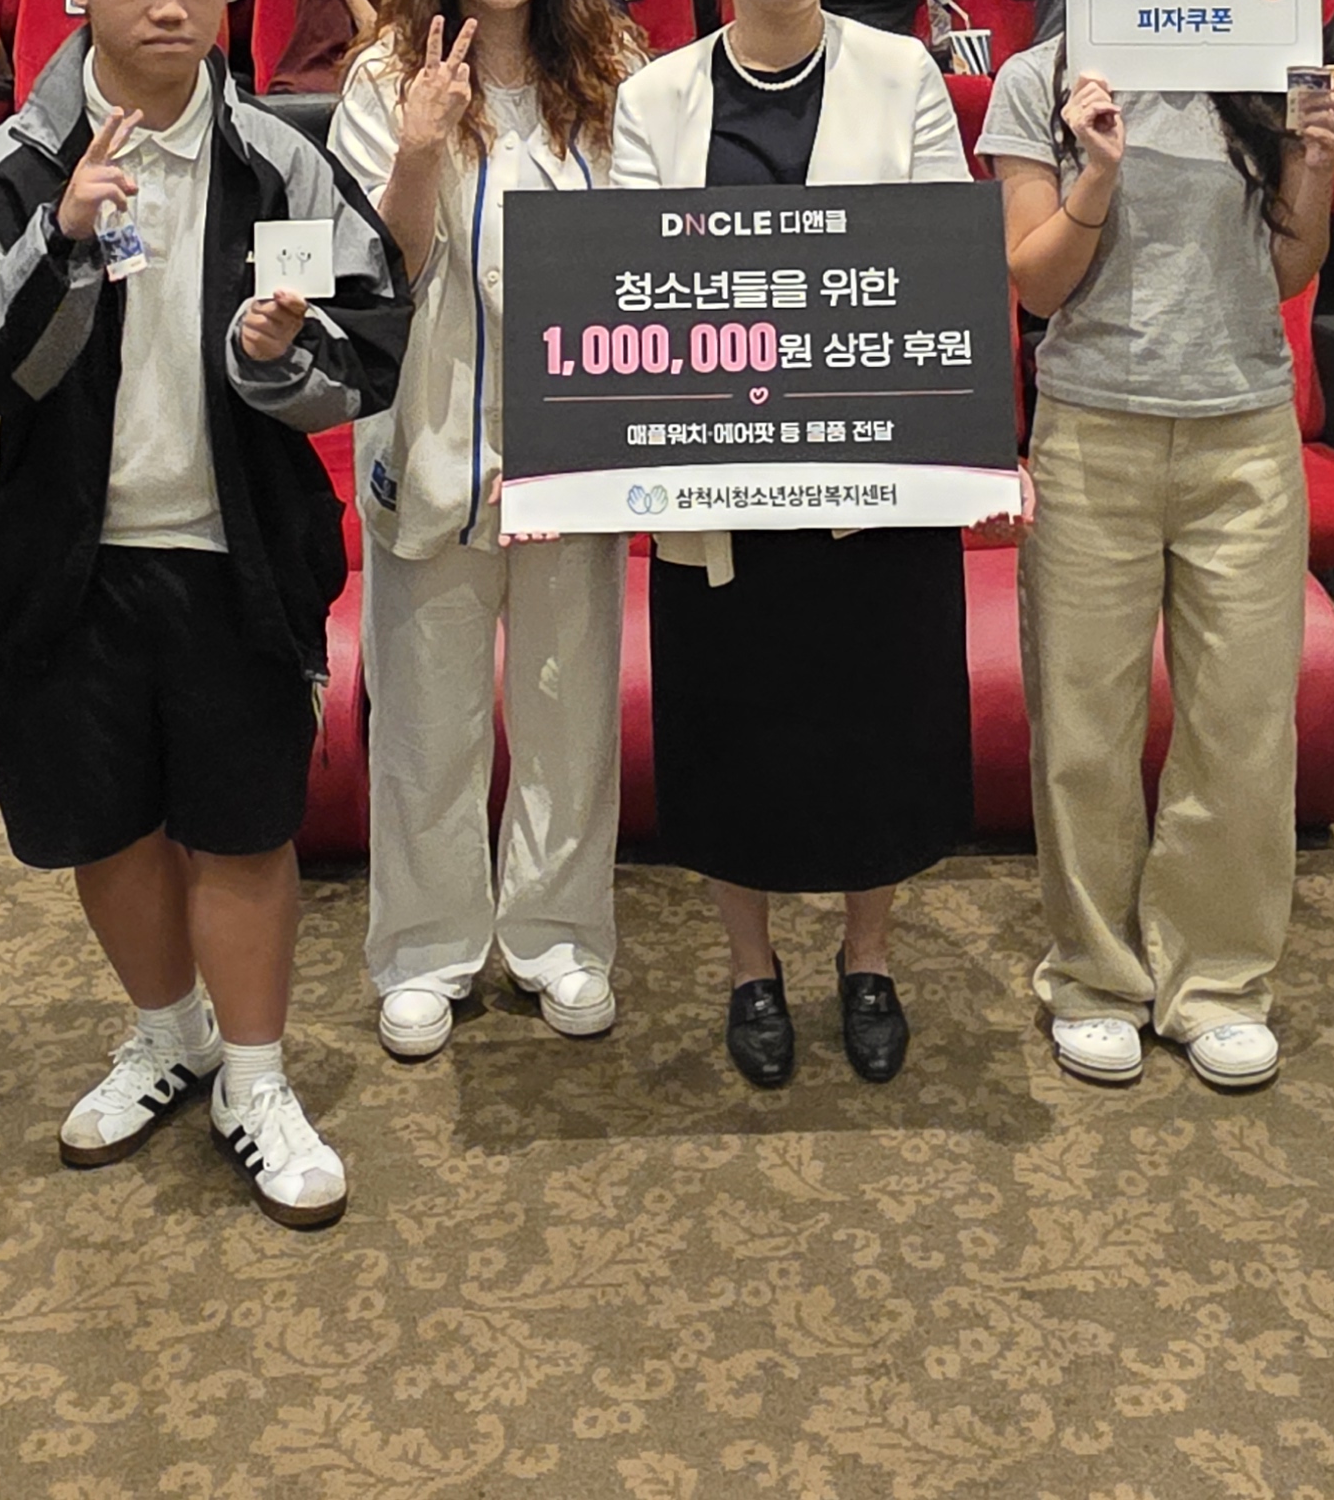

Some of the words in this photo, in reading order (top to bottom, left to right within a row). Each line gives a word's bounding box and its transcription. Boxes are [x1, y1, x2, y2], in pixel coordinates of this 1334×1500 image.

[1137, 7, 1233, 33] 피자쿠폰
[661, 211, 772, 237] DNCLE
[780, 209, 847, 234] 디앤클
[615, 269, 808, 311] 청소년들을
[820, 267, 900, 307] 위한
[543, 322, 813, 376] 1,000,000원
[823, 332, 894, 368] 상당
[903, 330, 973, 367] 후원
[780, 422, 800, 443] 등
[806, 421, 846, 443] 물품
[852, 420, 894, 442] 전달
[676, 483, 898, 509] 삼척시청소년상담복지센터
